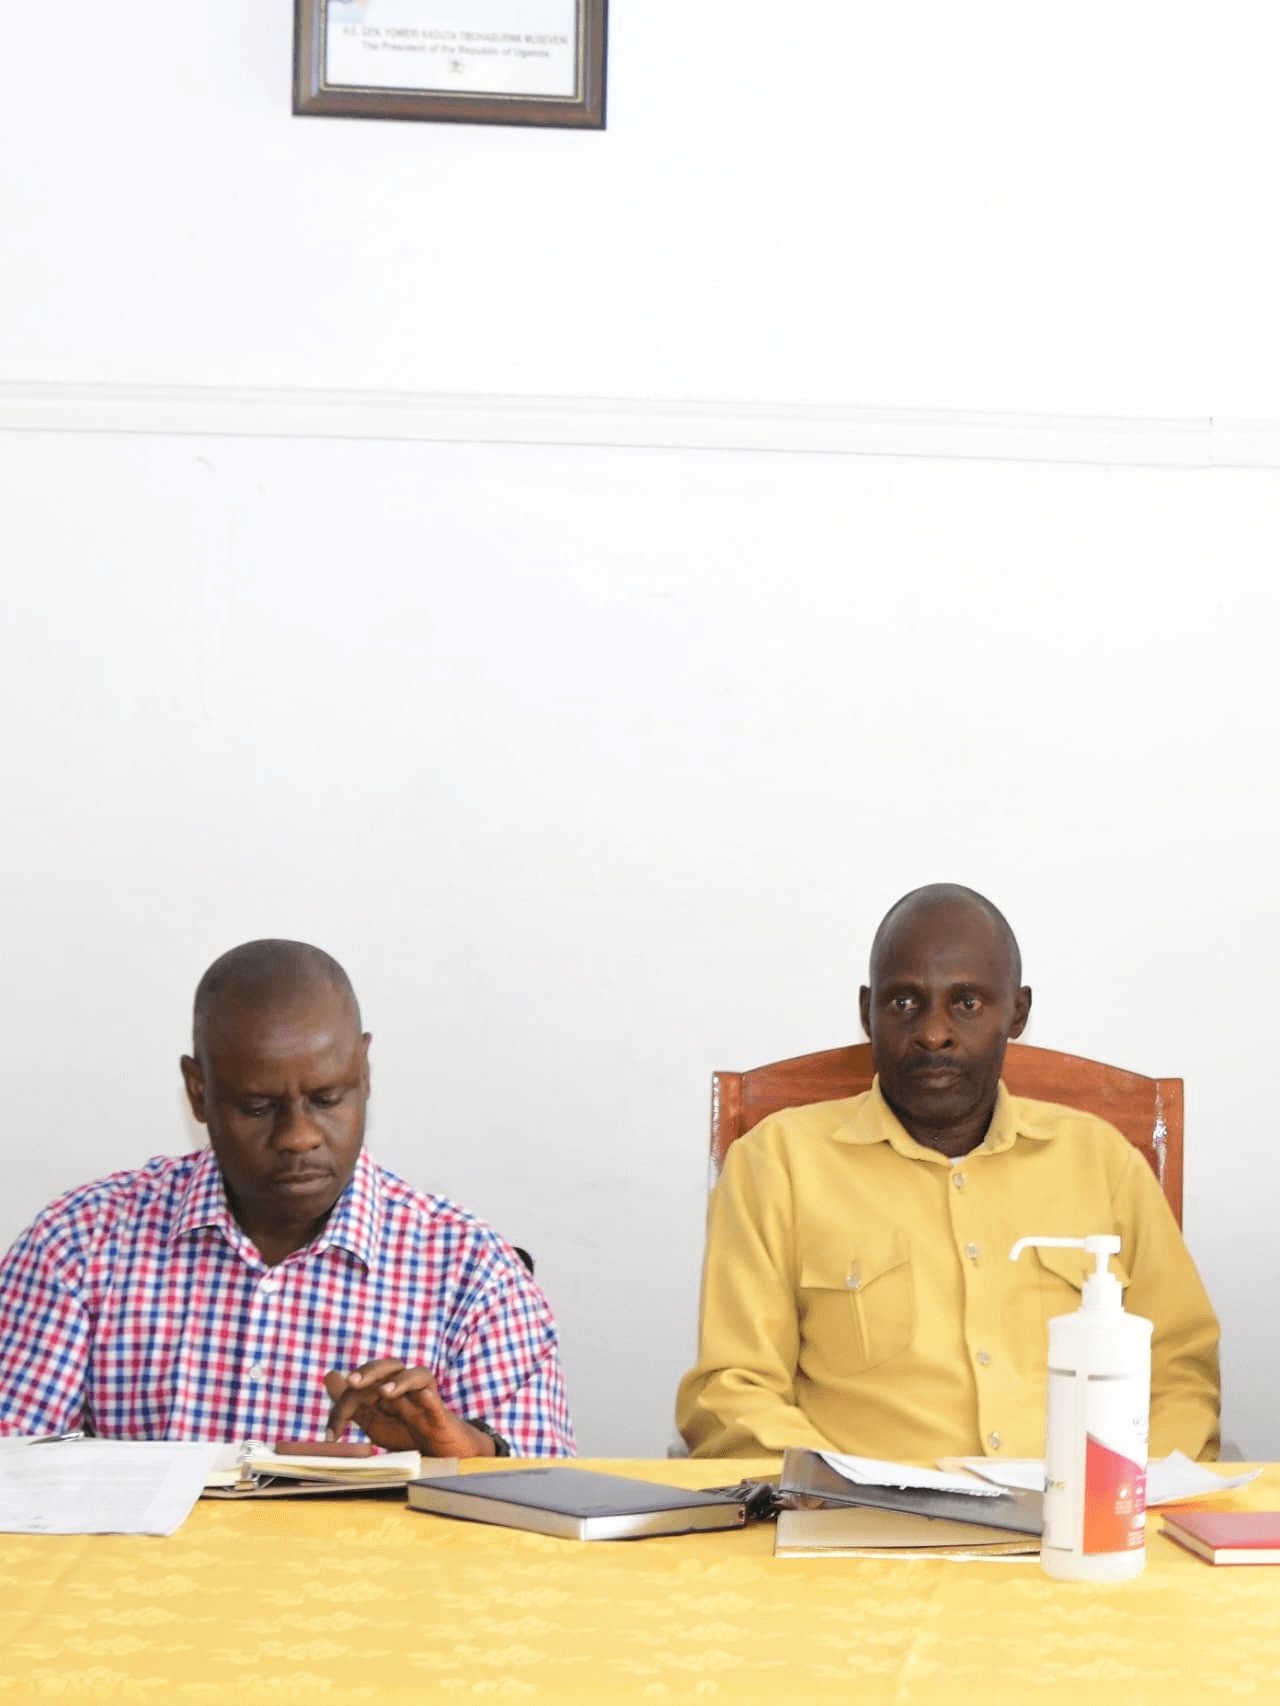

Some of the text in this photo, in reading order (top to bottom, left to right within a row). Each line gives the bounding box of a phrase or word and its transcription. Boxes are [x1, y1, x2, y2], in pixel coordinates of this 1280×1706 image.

[381, 42, 427, 52] President
[430, 43, 439, 52] of
[440, 44, 456, 53] the
[458, 45, 498, 56] Republic
[501, 46, 511, 56] of
[513, 48, 550, 58] Uganda
